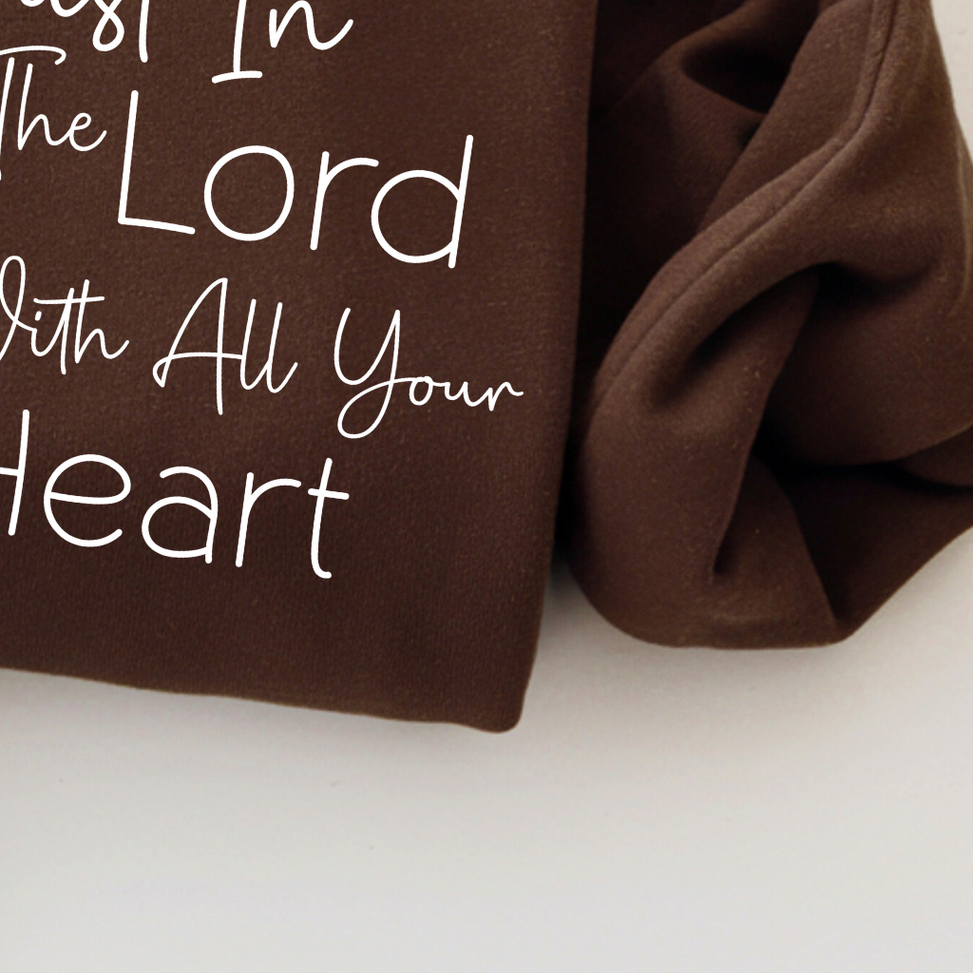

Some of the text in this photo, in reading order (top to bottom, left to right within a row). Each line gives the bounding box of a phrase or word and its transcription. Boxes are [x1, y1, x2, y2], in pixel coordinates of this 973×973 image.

[118, 90, 473, 268] Lord
[153, 278, 298, 415] All
[334, 308, 524, 439] Your
